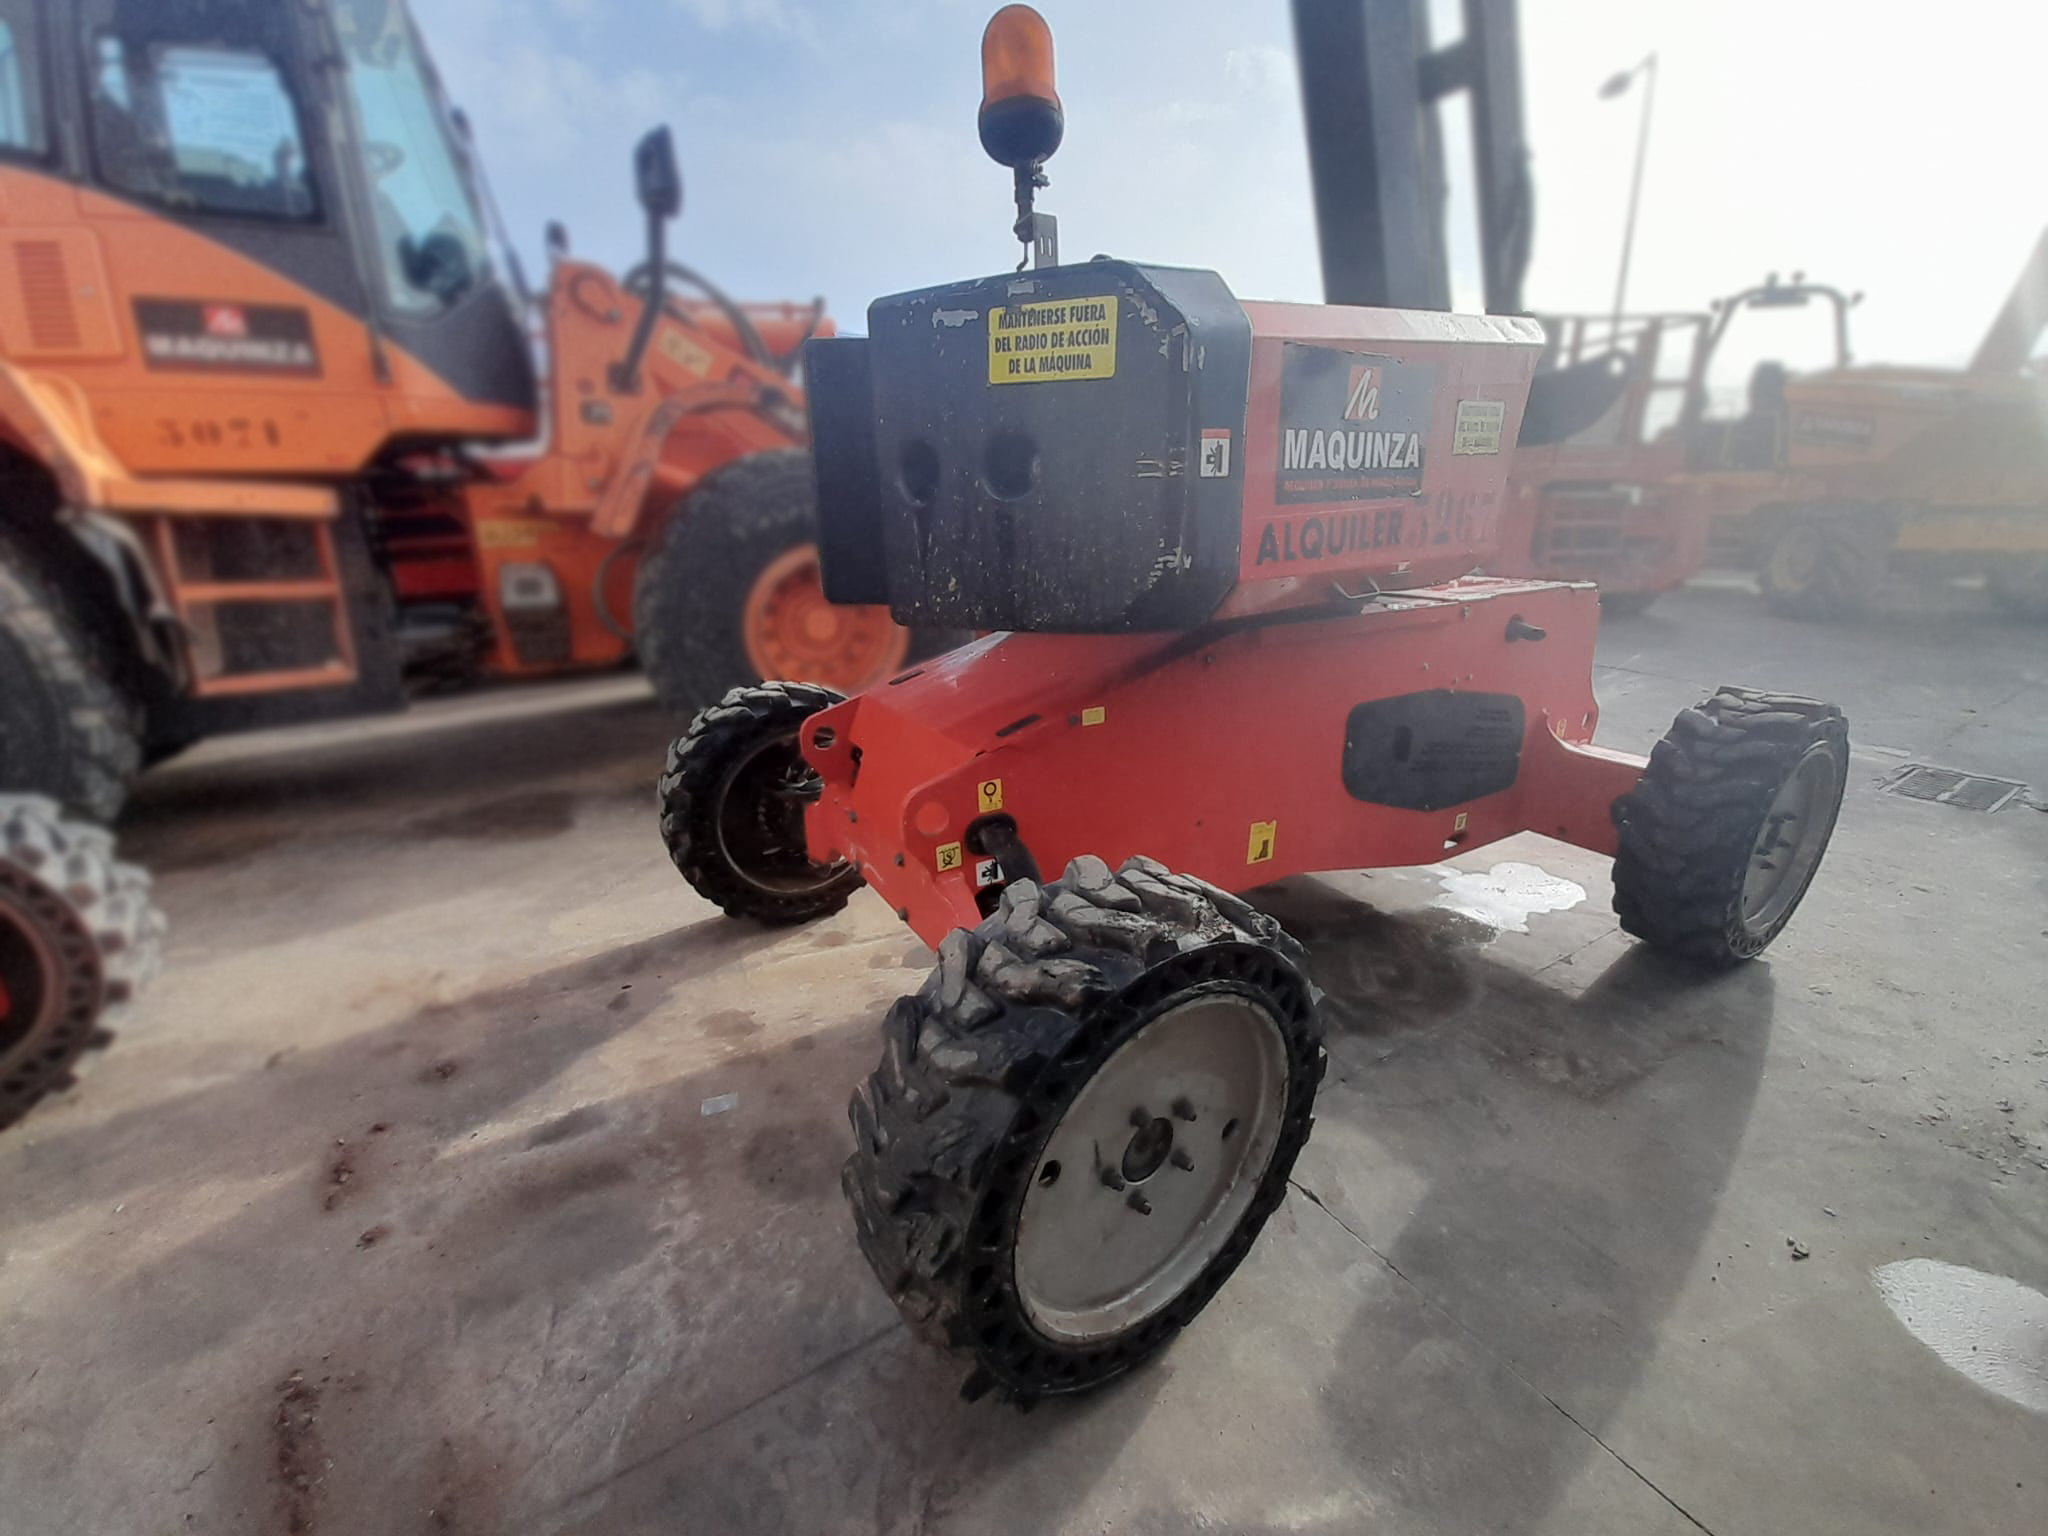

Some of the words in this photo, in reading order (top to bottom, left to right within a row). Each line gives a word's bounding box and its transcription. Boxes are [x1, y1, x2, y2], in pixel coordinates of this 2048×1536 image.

[998, 307, 1066, 330] MANTENERSE
[1069, 303, 1106, 323] FUERA
[995, 335, 1011, 353] DEL
[1015, 332, 1047, 351] RADIO
[1051, 330, 1065, 348] DE
[1067, 324, 1109, 347] ACCIÓN
[1008, 358, 1020, 374] DE
[1024, 356, 1036, 373] LA
[1039, 351, 1092, 372] MÁQUINA
[1283, 429, 1420, 471] MAQUINZA
[1256, 509, 1404, 566] ALQUILER
